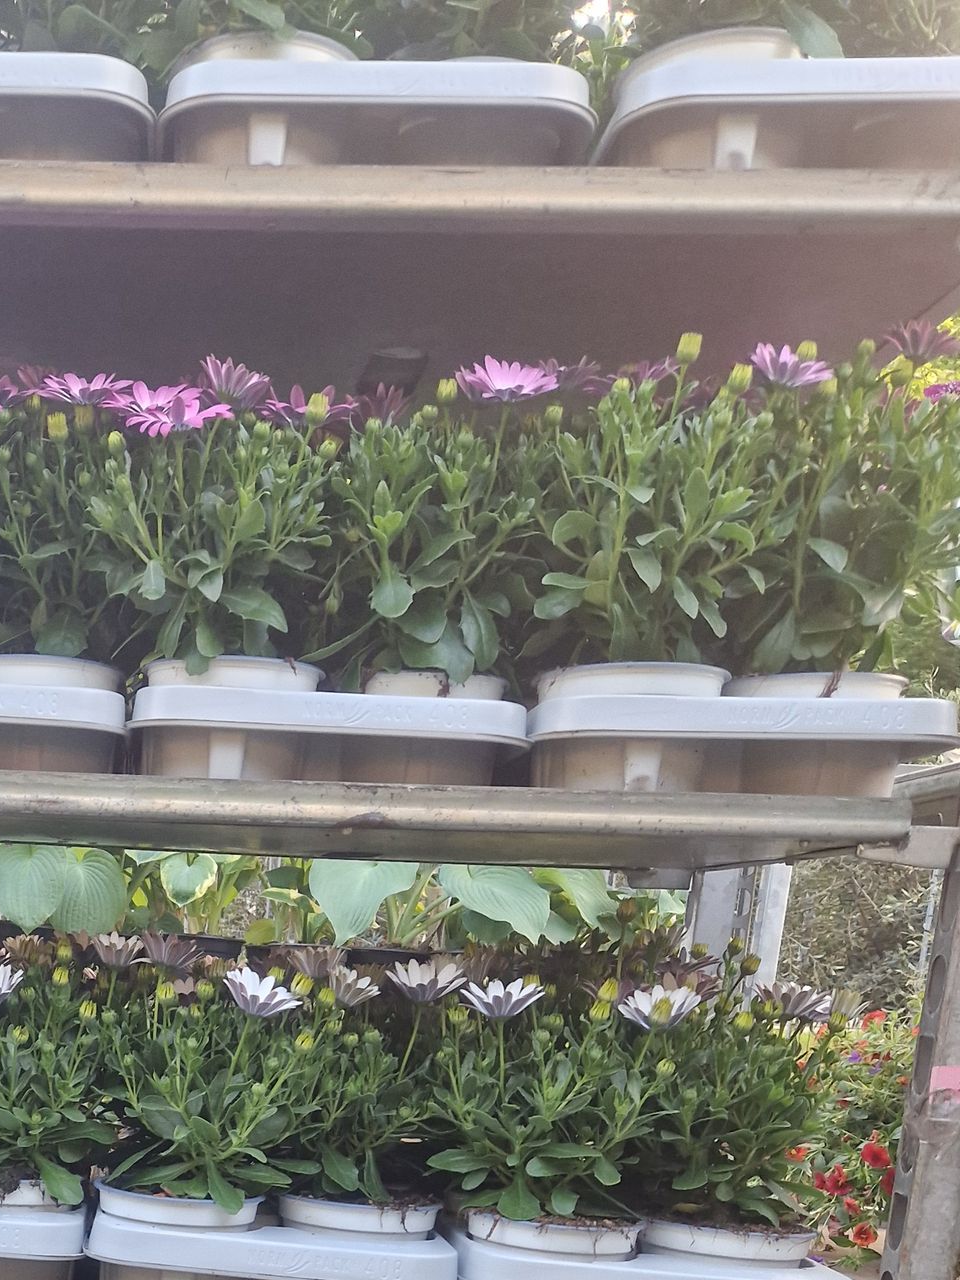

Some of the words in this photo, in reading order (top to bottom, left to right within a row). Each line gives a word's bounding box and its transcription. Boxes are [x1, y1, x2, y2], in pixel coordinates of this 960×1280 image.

[429, 704, 470, 729] 408
[862, 706, 905, 730] 408
[363, 1258, 403, 1280] 408
